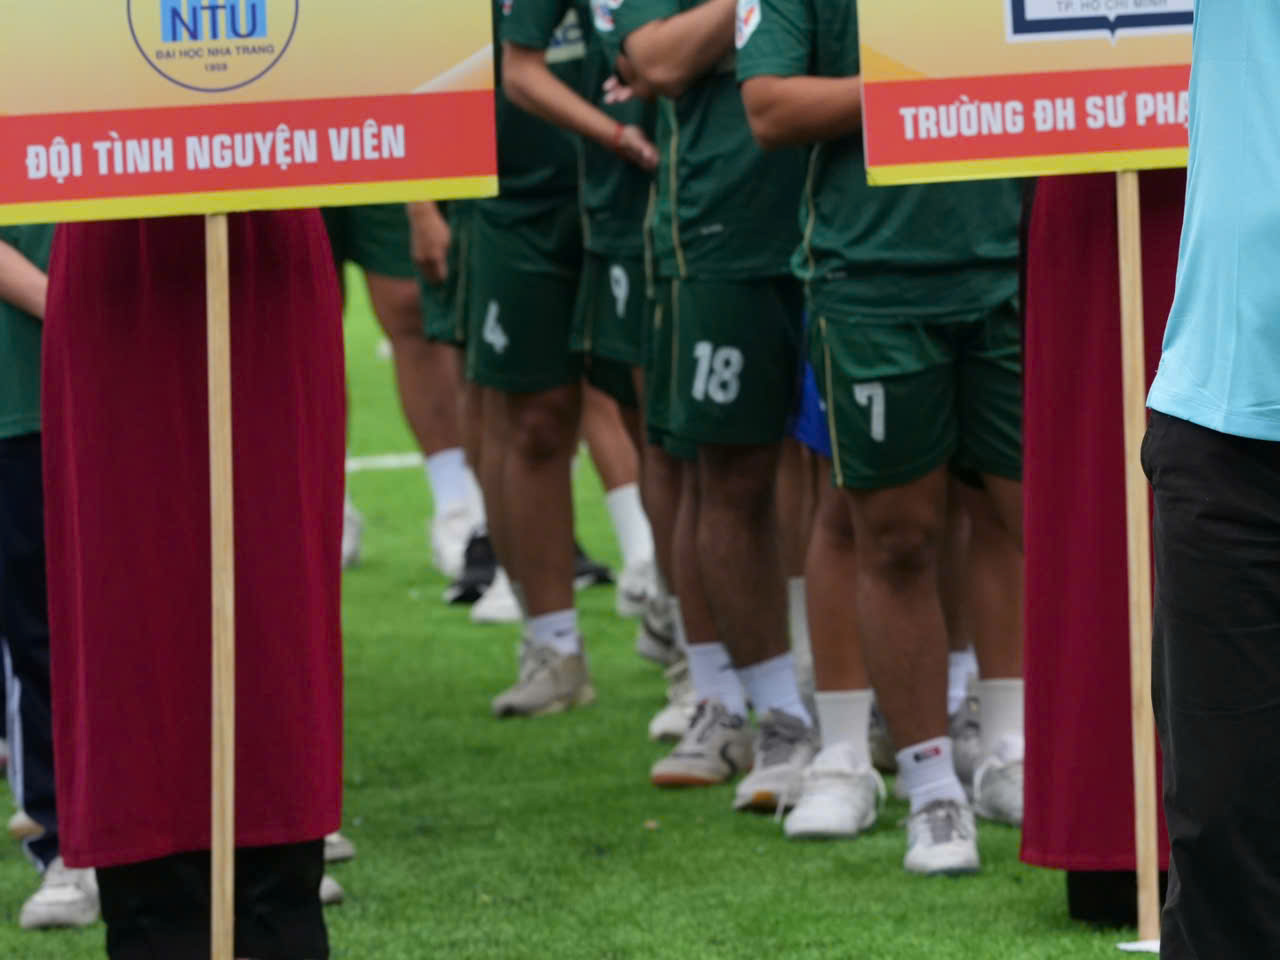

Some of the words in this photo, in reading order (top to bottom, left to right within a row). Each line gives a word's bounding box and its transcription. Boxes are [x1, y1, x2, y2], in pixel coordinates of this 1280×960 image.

[171, 2, 257, 42] NTU
[208, 46, 232, 57] NHA
[236, 44, 275, 56] TRANG
[899, 94, 1025, 141] TRƯỜNG
[1033, 97, 1076, 132] ĐH
[1085, 91, 1129, 129] SƯ
[1136, 90, 1190, 129] PHẠ
[25, 136, 83, 184] ĐỘI
[93, 130, 175, 176] TÌNH
[186, 123, 318, 171] NGUYỆN
[328, 118, 406, 162] VIÊN
[609, 264, 630, 318] 9
[482, 299, 510, 354] 4
[691, 341, 744, 404] 18
[852, 382, 886, 443] 7
